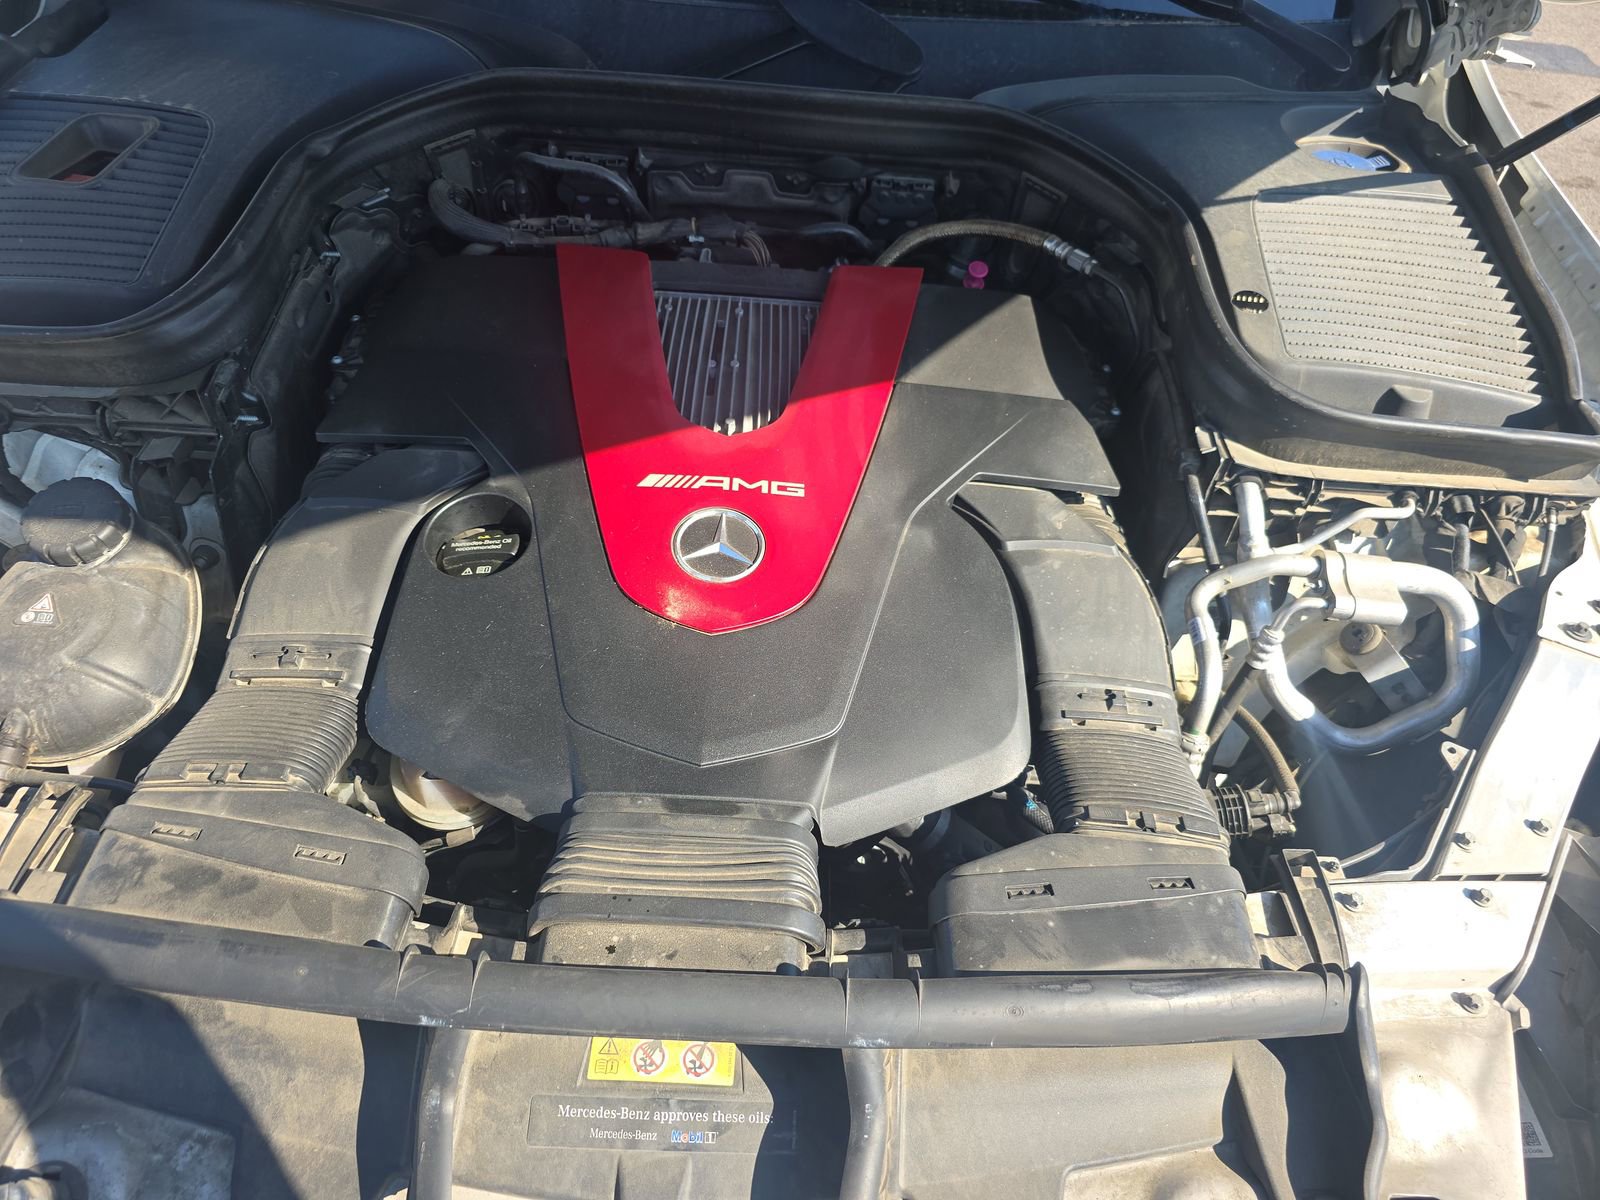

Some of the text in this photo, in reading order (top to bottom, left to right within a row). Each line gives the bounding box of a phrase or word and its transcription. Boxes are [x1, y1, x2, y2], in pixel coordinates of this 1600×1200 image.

[691, 475, 805, 498] AMG
[450, 539, 501, 548] Mercedes-Benz
[557, 1104, 774, 1124] Mercedes-Benz approves these oils:
[589, 1127, 658, 1141] Mercedes-Benz
